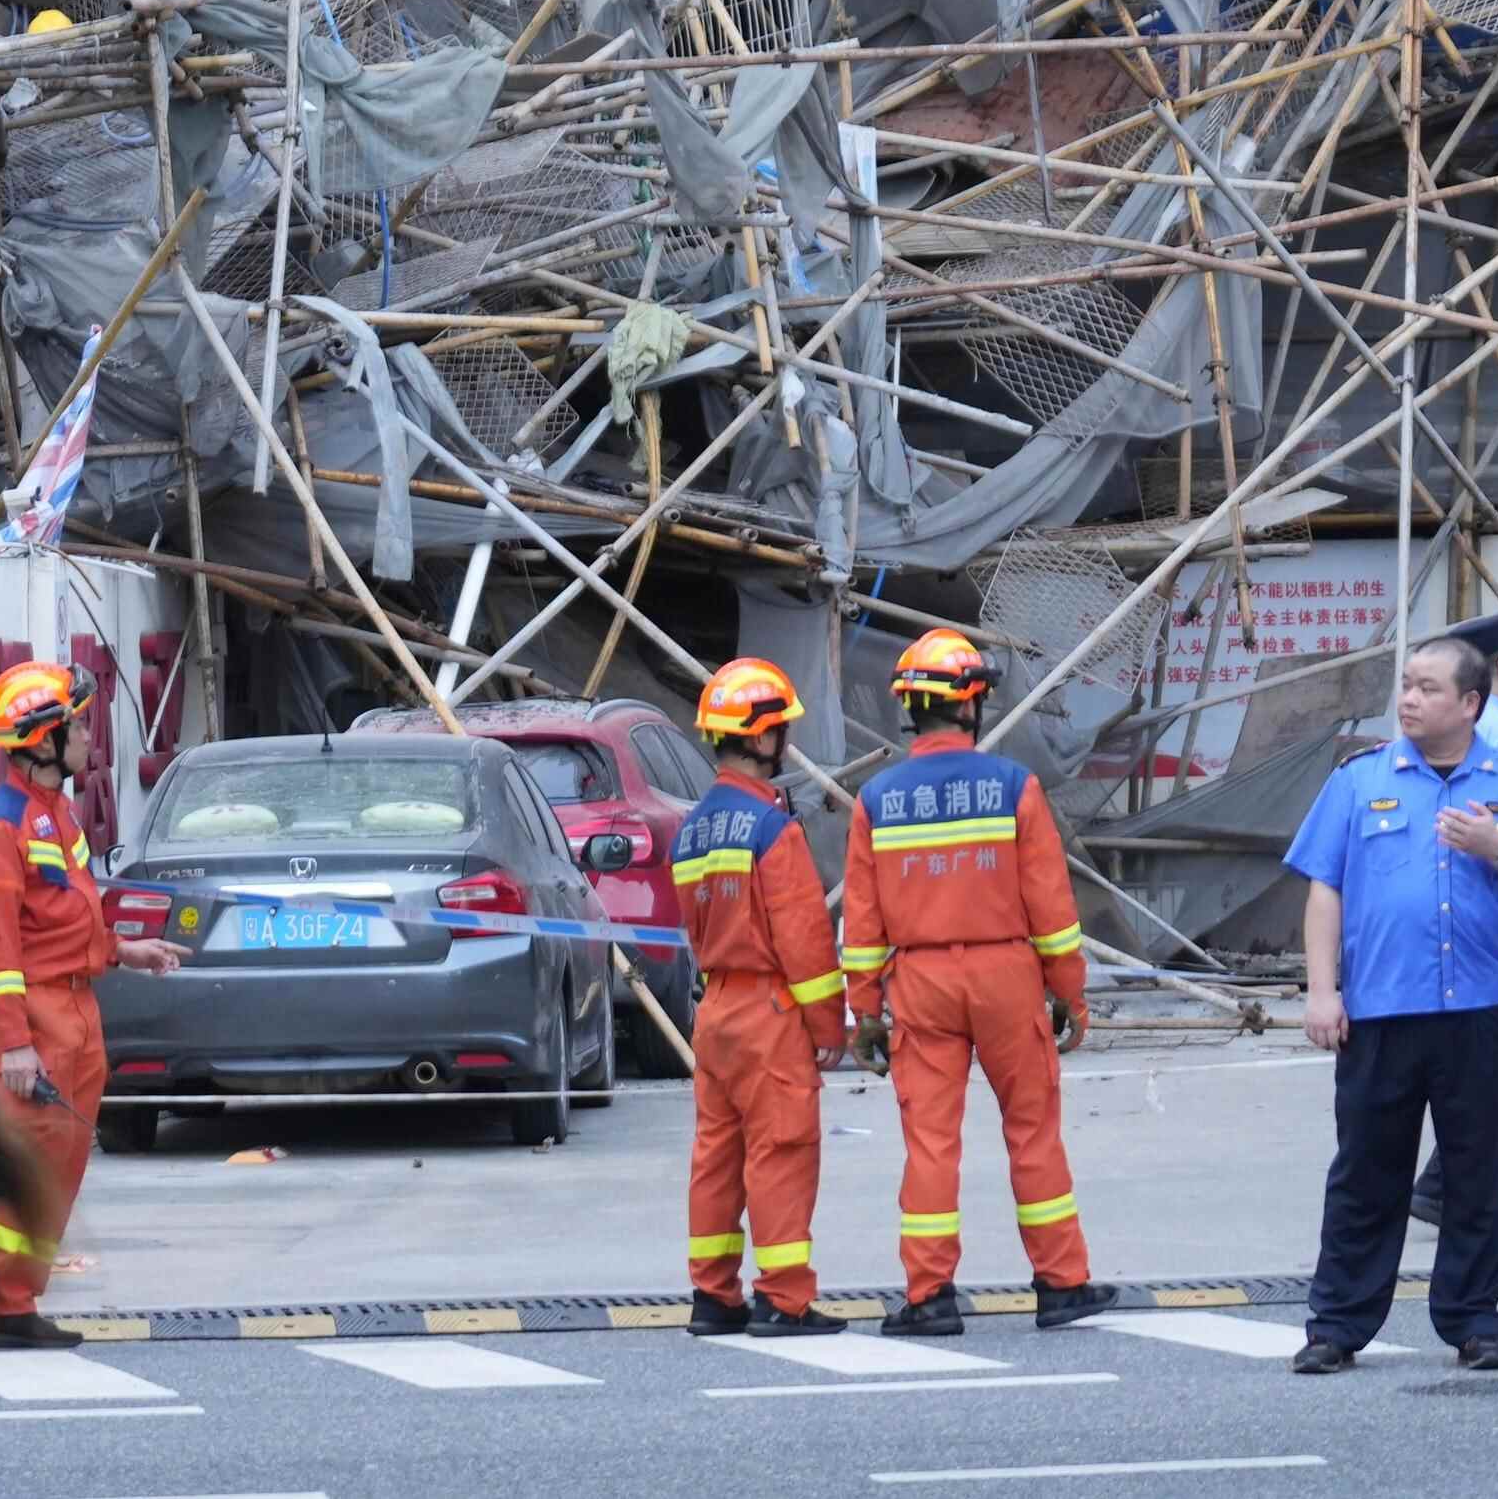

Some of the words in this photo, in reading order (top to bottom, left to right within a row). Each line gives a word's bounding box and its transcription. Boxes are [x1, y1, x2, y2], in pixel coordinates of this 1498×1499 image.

[880, 777, 1004, 821] 应急消防
[678, 810, 757, 855] 应急消防
[903, 847, 997, 878] 广东广州
